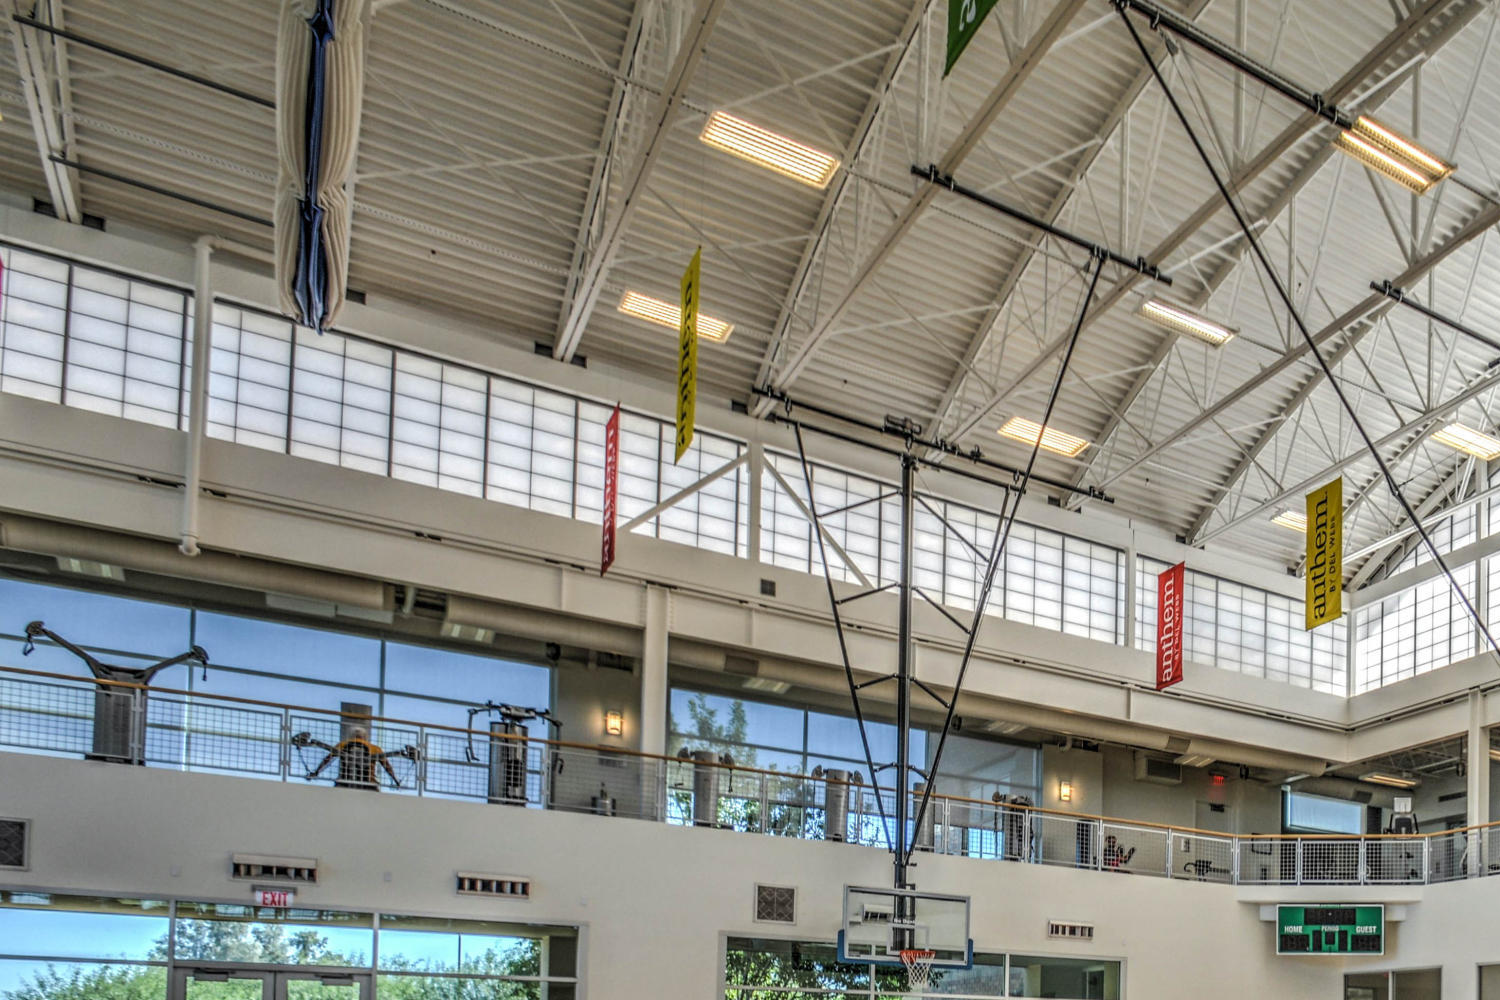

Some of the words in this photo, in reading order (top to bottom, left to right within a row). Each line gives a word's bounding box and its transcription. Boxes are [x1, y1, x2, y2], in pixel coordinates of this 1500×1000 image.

[1329, 554, 1337, 575] DEL
[262, 891, 288, 907] EXIT
[1284, 925, 1303, 934] HOME
[1355, 925, 1377, 934] GUEST
